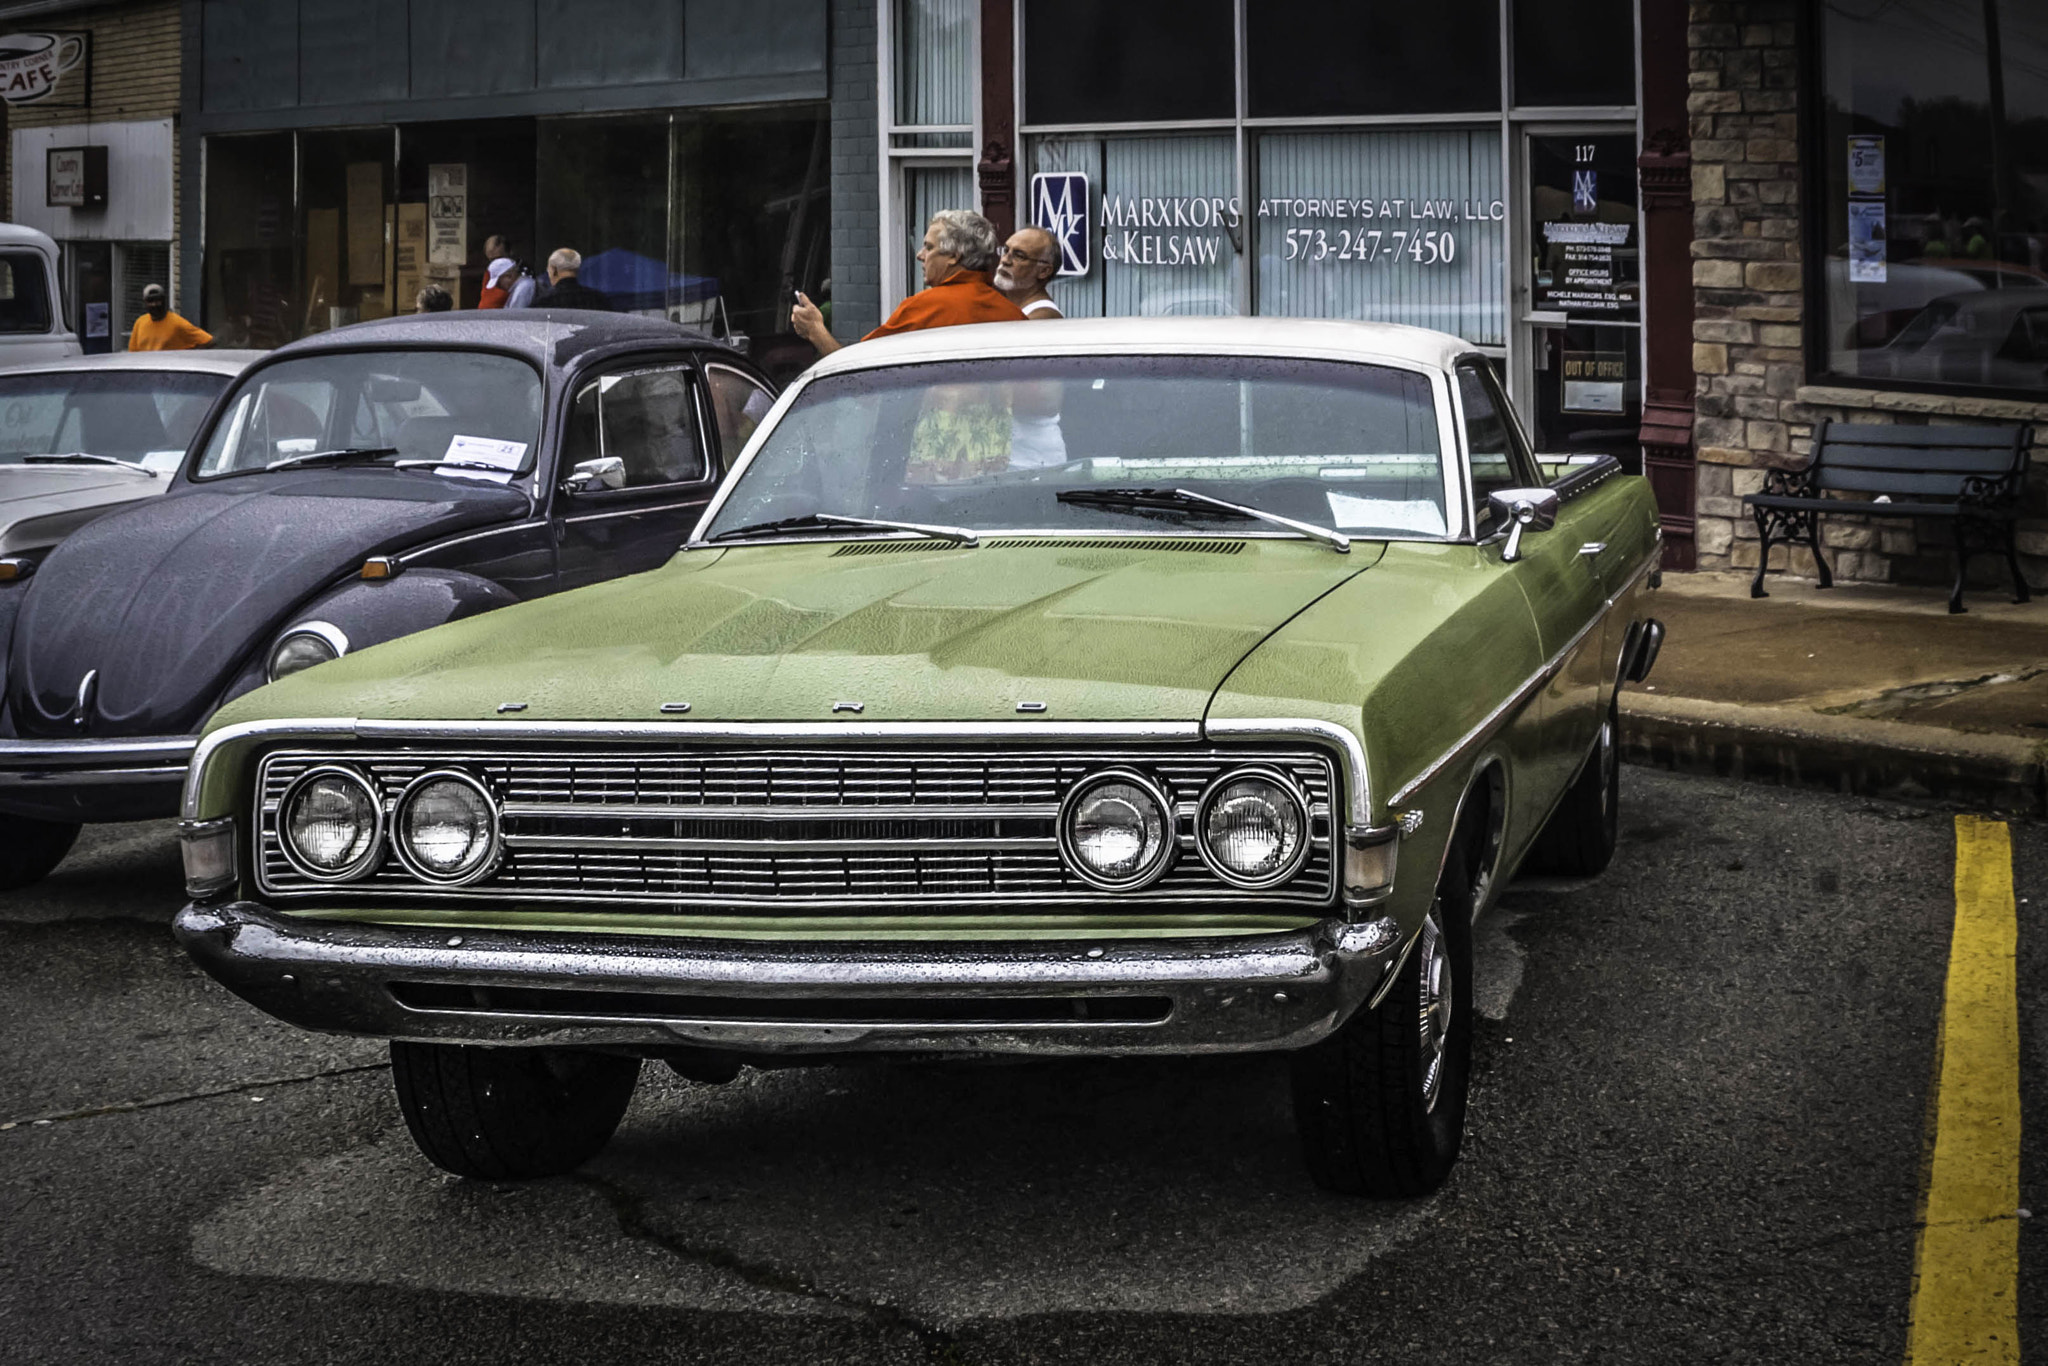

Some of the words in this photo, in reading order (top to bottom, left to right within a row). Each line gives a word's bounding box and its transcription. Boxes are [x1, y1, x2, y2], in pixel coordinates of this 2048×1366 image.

[1575, 144, 1596, 162] 117
[1100, 193, 1240, 228] MARXKORS
[1257, 198, 1374, 219] ATTORNEYS
[1379, 199, 1405, 220] AT
[1410, 200, 1460, 223] LAW,
[1465, 200, 1505, 221] LLC
[1102, 234, 1119, 261] &
[1123, 230, 1220, 266] KELSAW
[1285, 226, 1455, 265] 573-247-7450
[1568, 268, 1588, 276] OFFICE
[1589, 268, 1609, 277] HOURS
[1573, 277, 1613, 285] APPOINTMENT
[1565, 360, 1583, 377] OUT
[1585, 360, 1595, 377] OF
[1598, 360, 1624, 377] OFFICE
